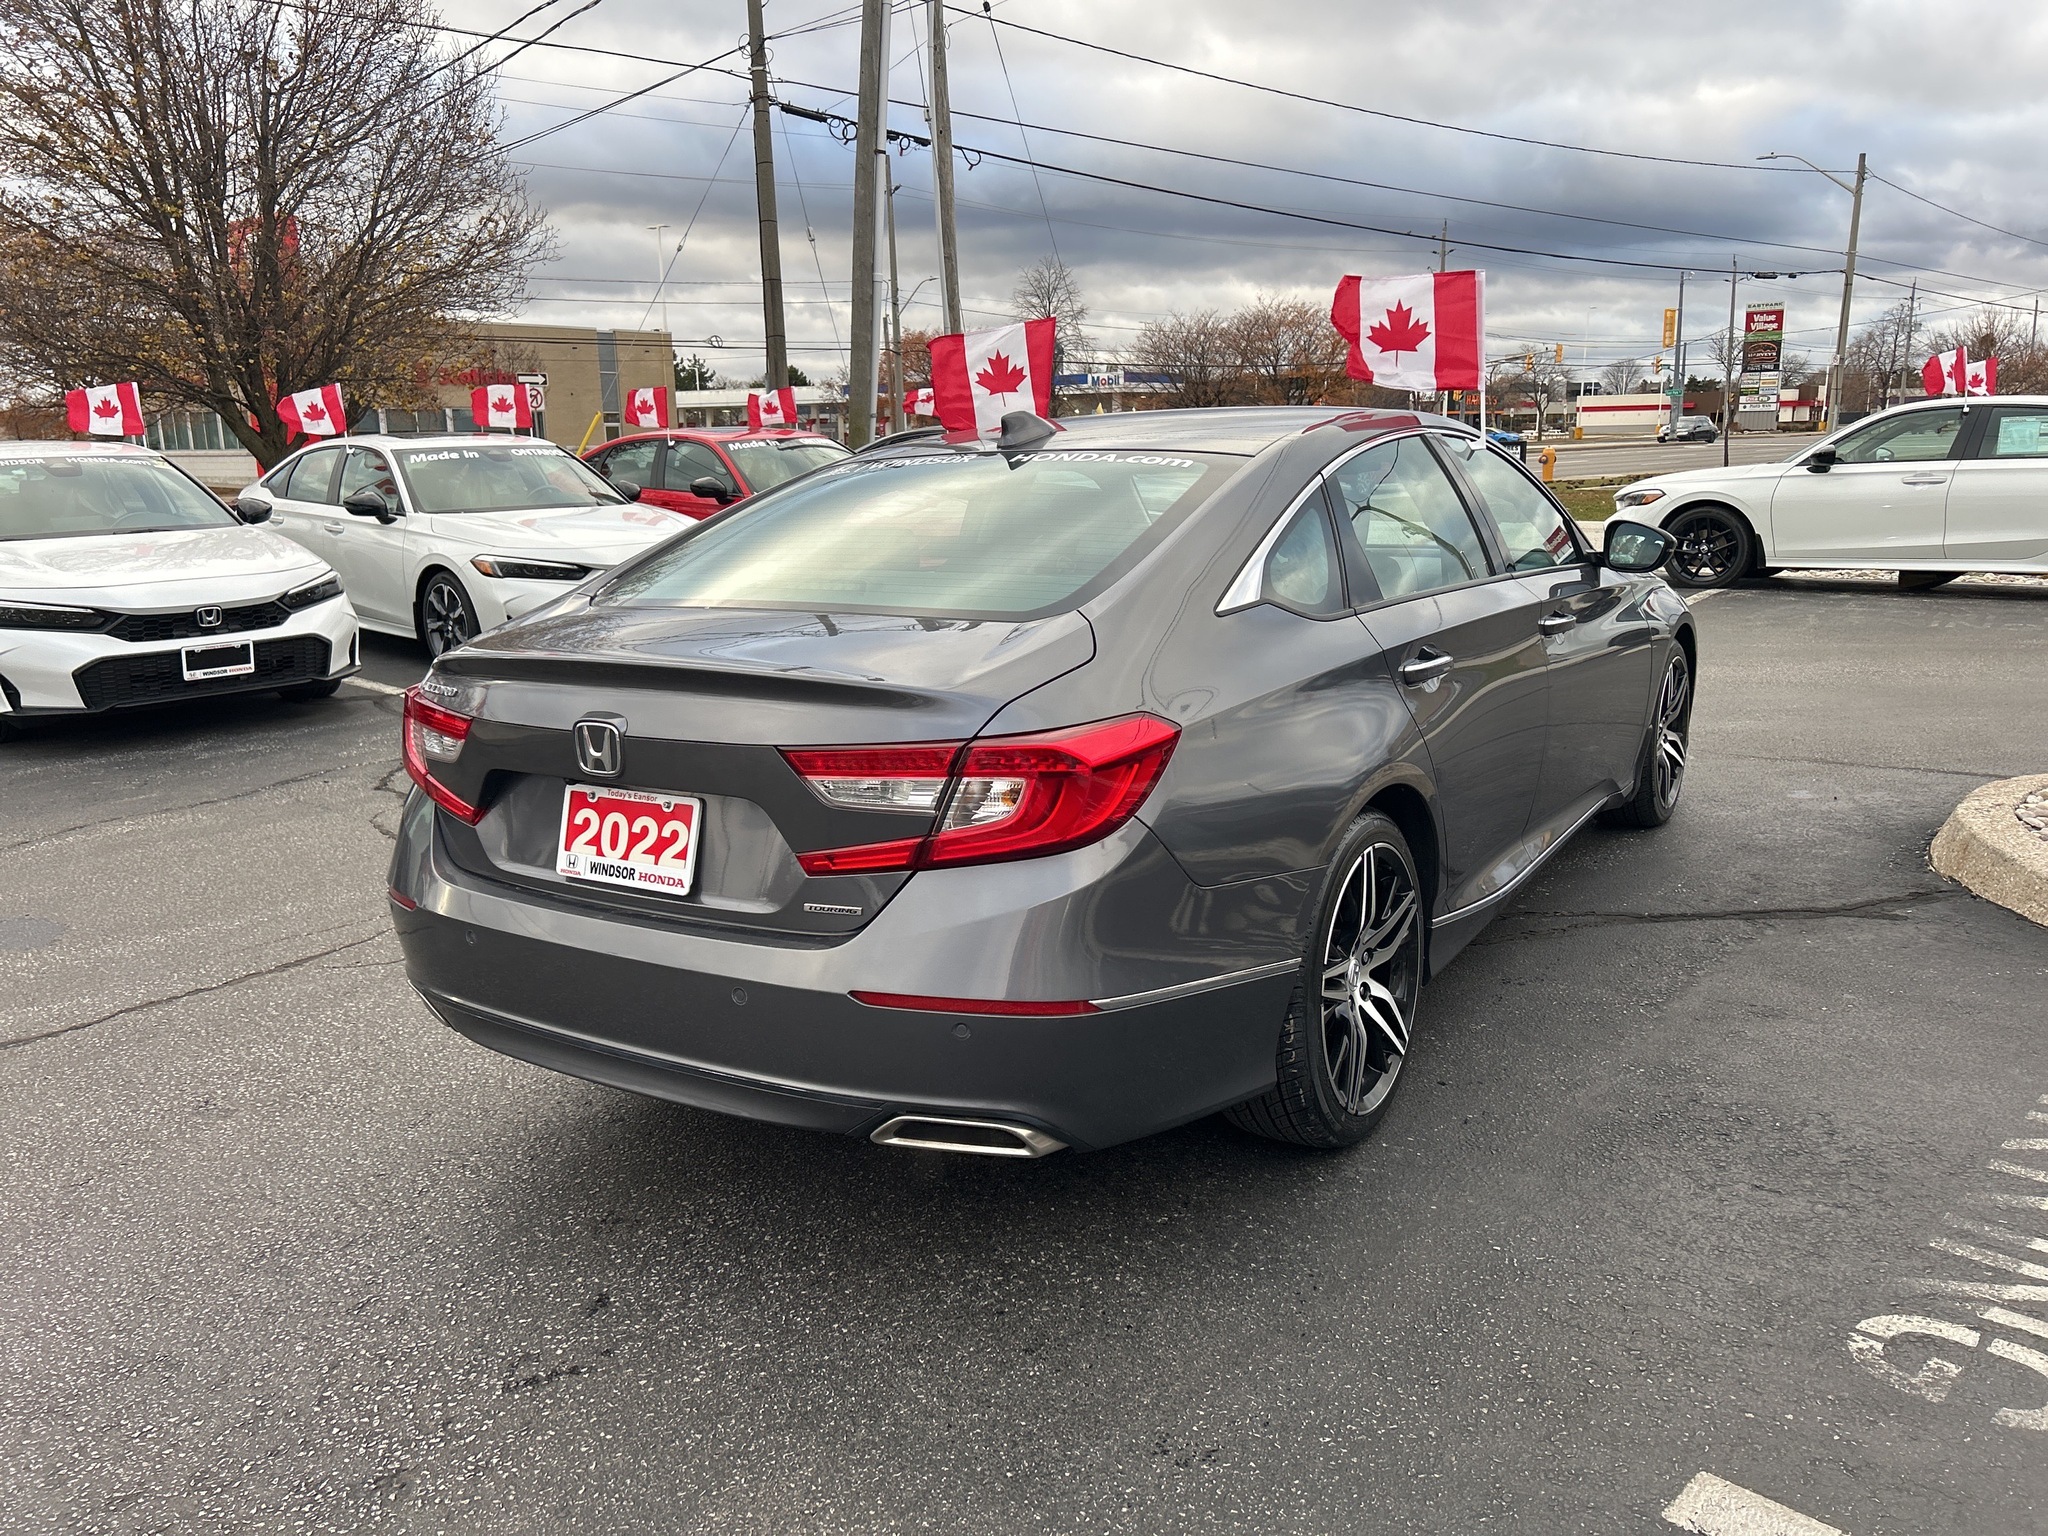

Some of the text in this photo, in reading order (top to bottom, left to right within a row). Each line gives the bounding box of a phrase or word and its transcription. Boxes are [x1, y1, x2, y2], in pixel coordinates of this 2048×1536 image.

[1753, 313, 1777, 322] Value
[1750, 322, 1779, 331] Village
[439, 368, 537, 385] Scotiaba
[1092, 375, 1120, 386] Mobil
[728, 440, 766, 451] Made
[65, 457, 151, 466] HONDA.com
[410, 451, 463, 464] Made
[1009, 453, 1194, 468] HONDA.com
[202, 668, 228, 677] WINDSOR
[607, 788, 632, 799] Today's
[570, 807, 690, 869] 2022
[560, 868, 582, 877] HONDA
[589, 860, 686, 889] WINDSOR HONDA
[808, 905, 858, 915] TOURING
